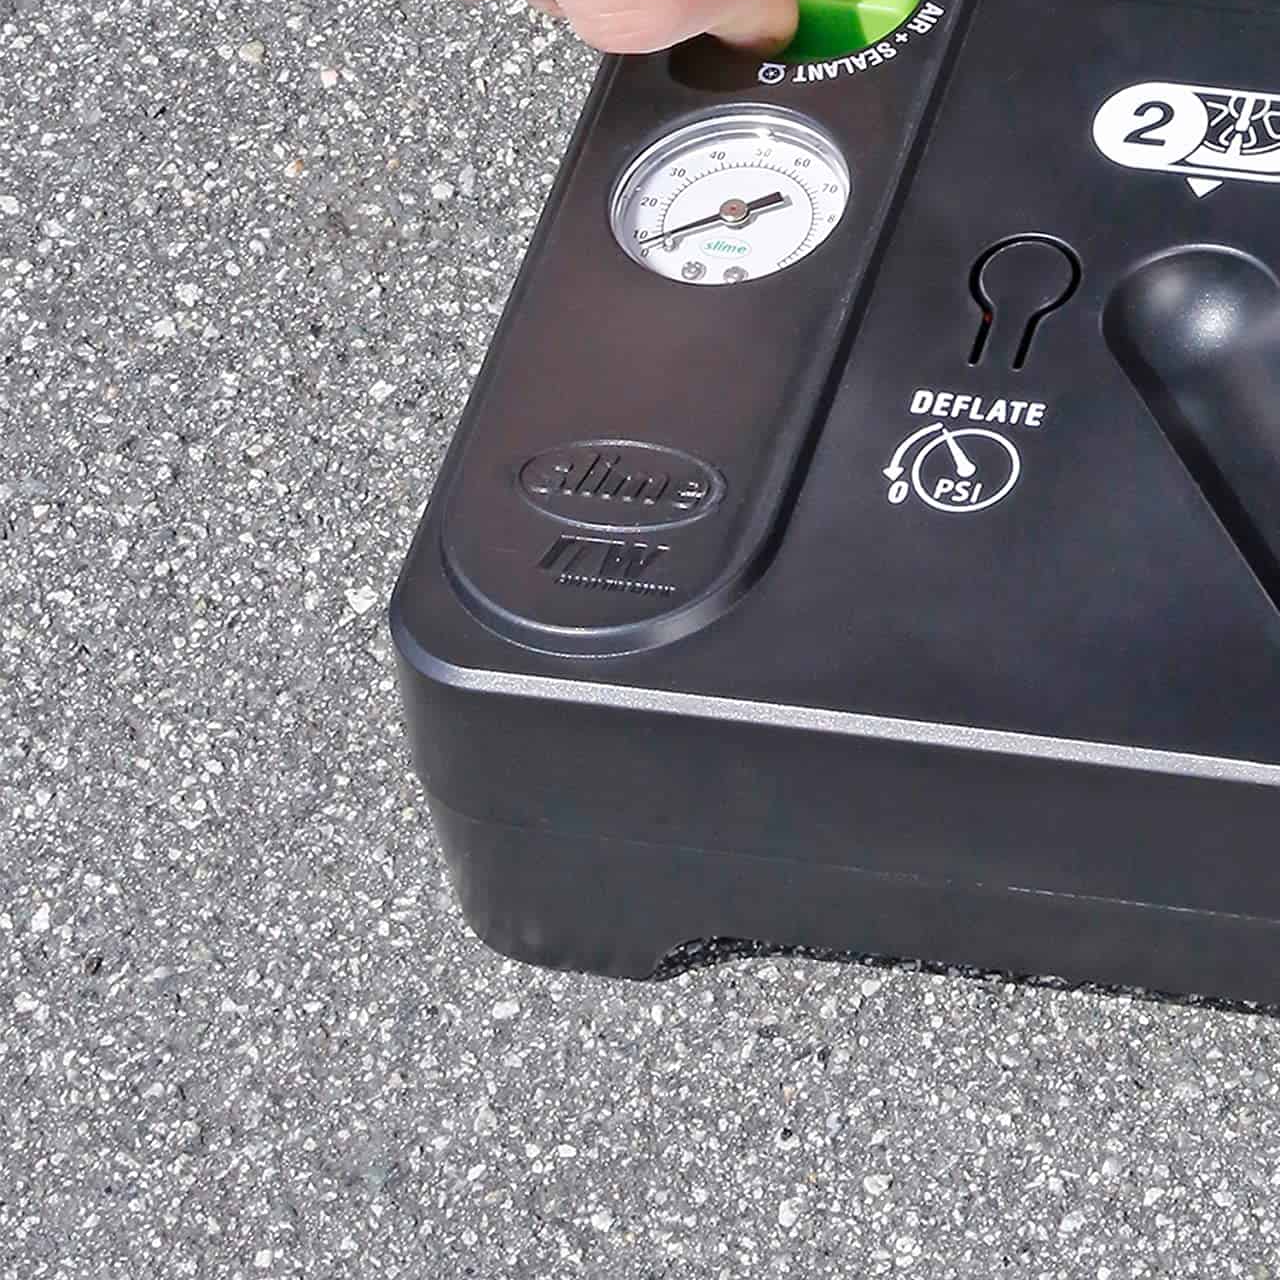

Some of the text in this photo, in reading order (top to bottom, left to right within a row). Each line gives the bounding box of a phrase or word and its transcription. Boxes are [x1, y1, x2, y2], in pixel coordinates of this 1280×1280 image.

[792, 1, 945, 83] AIR + SEALANT
[1123, 100, 1175, 147] 2
[709, 150, 726, 161] 40
[793, 156, 812, 168] 60
[669, 167, 687, 178] 30
[821, 182, 839, 194] 70
[640, 196, 658, 208] 20
[632, 229, 649, 240] 10
[640, 247, 649, 258] 0
[703, 238, 748, 255] slime
[910, 389, 1047, 426] DEFLATE
[526, 453, 707, 510] slime
[887, 480, 910, 504] 0
[933, 478, 984, 504] PSI
